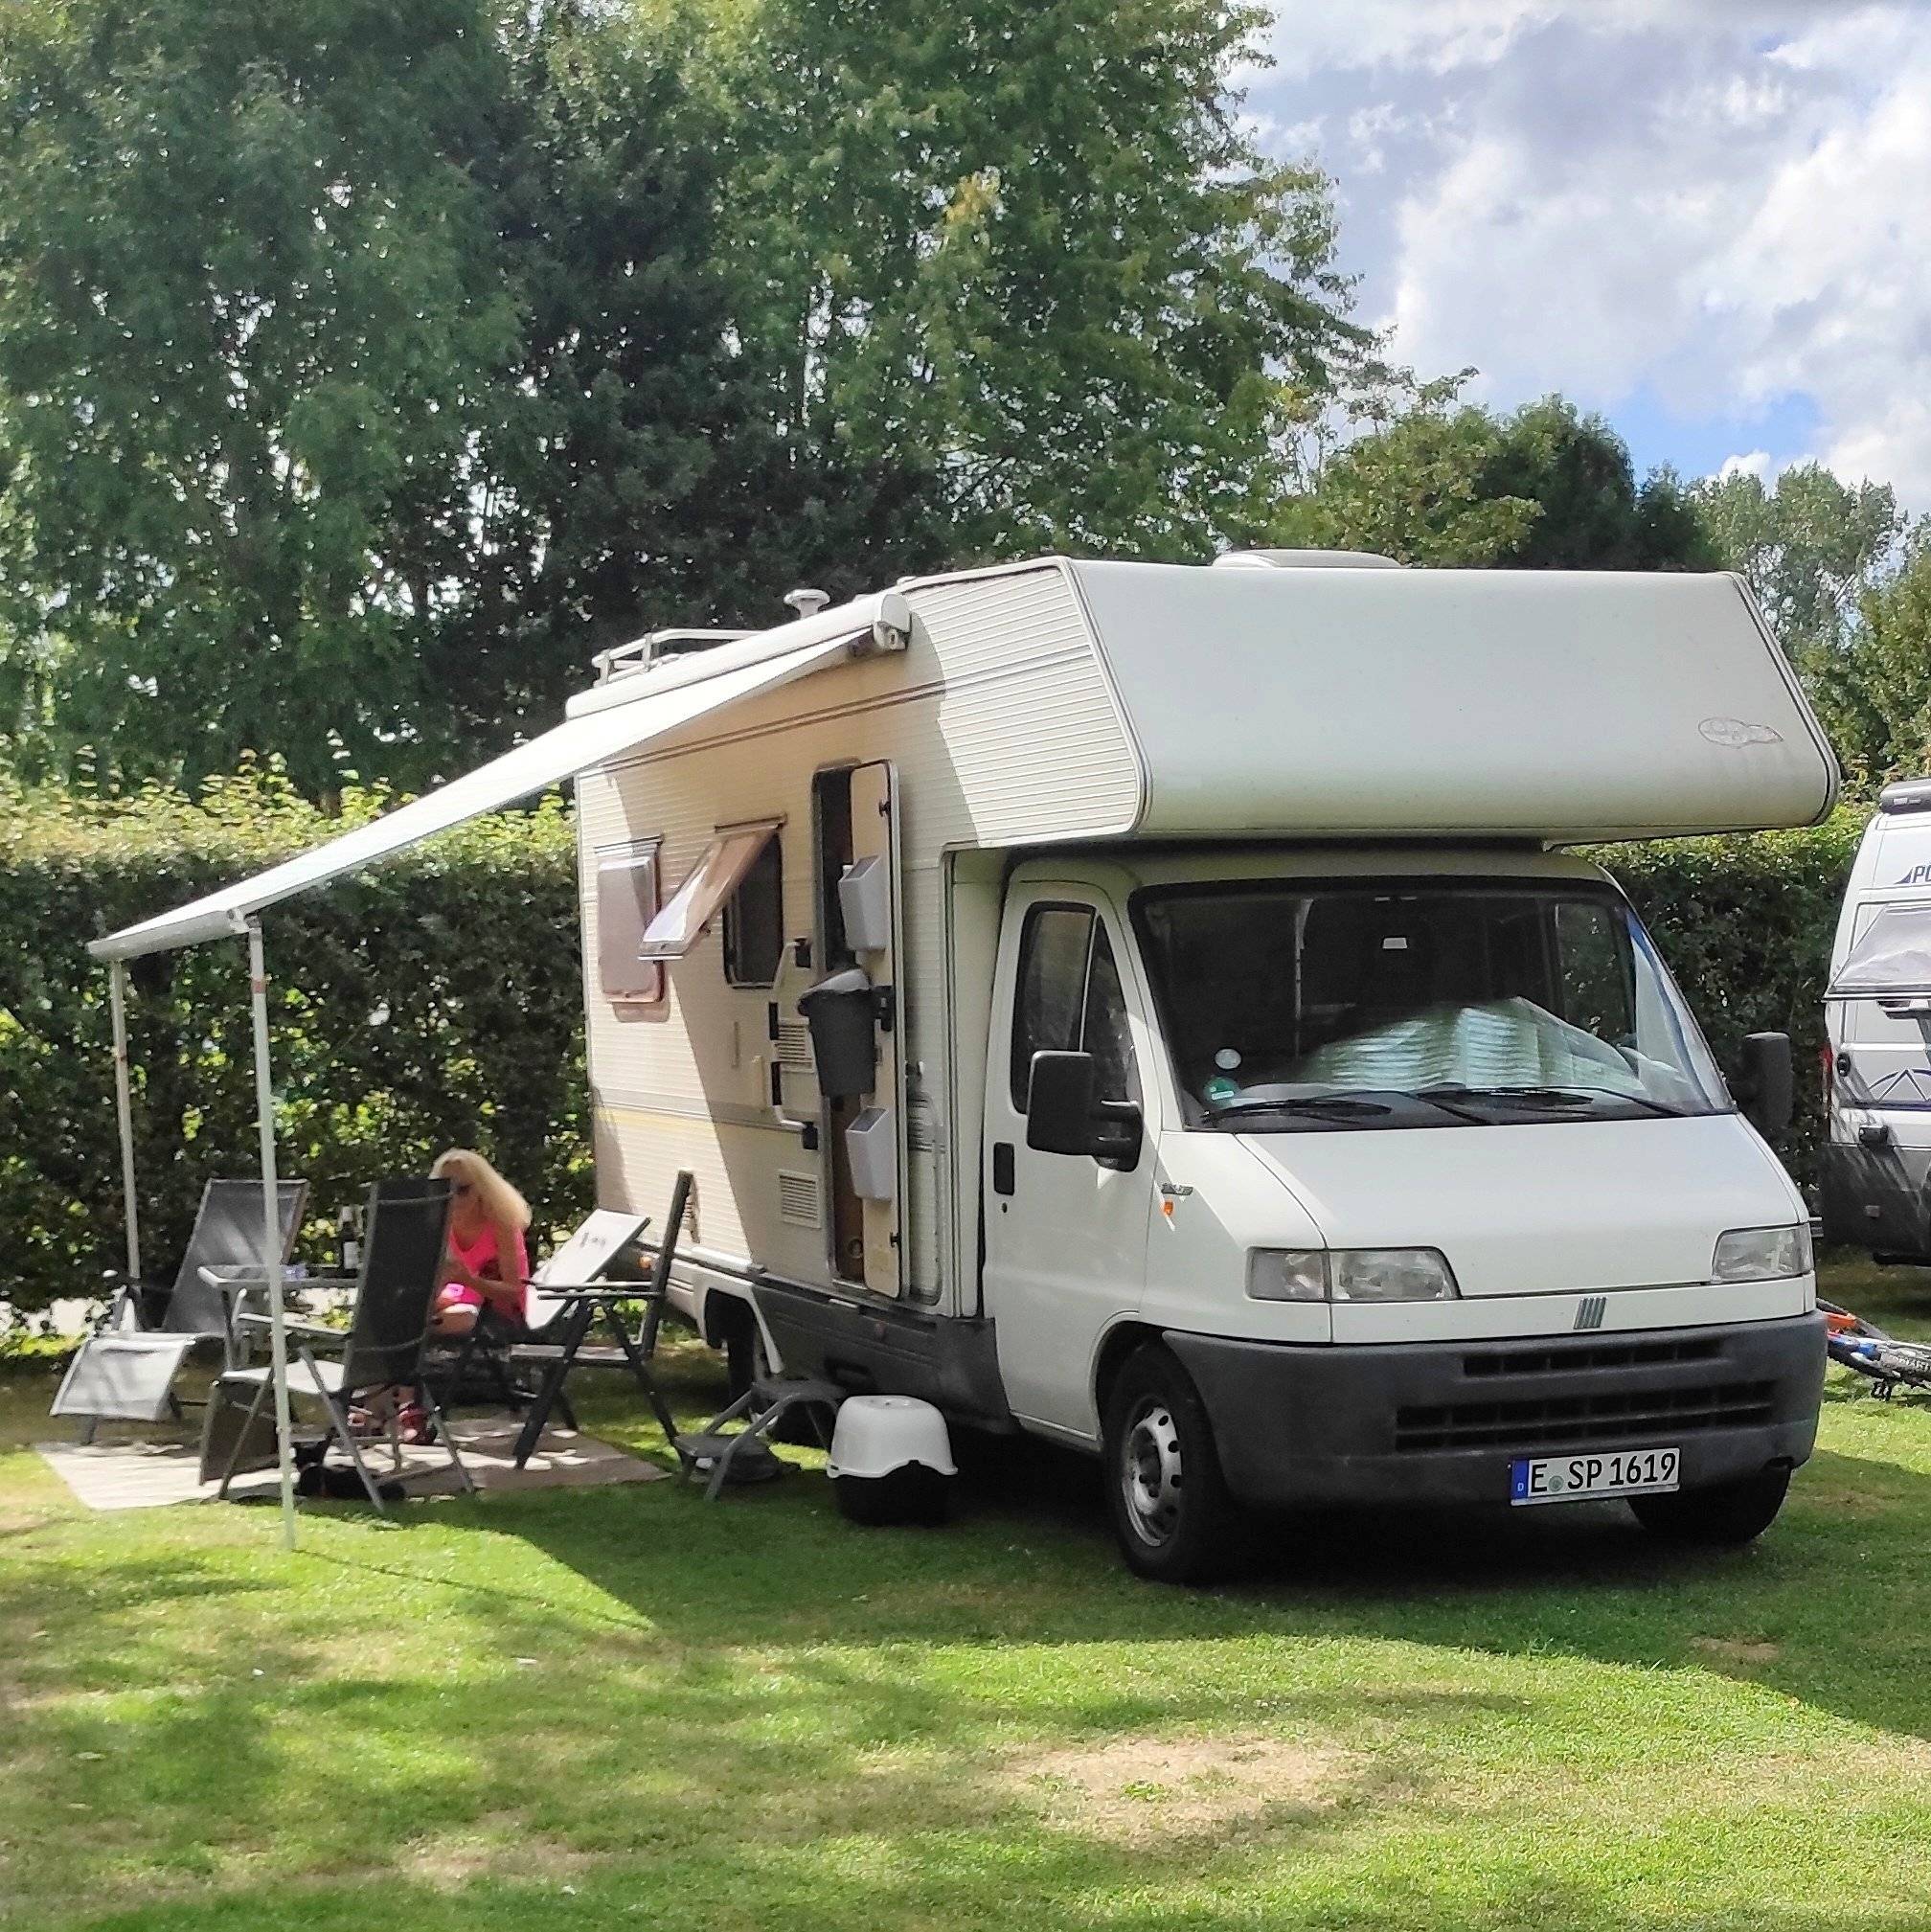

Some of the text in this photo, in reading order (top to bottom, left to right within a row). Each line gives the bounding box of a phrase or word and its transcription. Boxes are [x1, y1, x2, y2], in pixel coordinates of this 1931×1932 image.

[1532, 1452, 1676, 1492] E SP 1619
[1517, 1482, 1525, 1492] D
